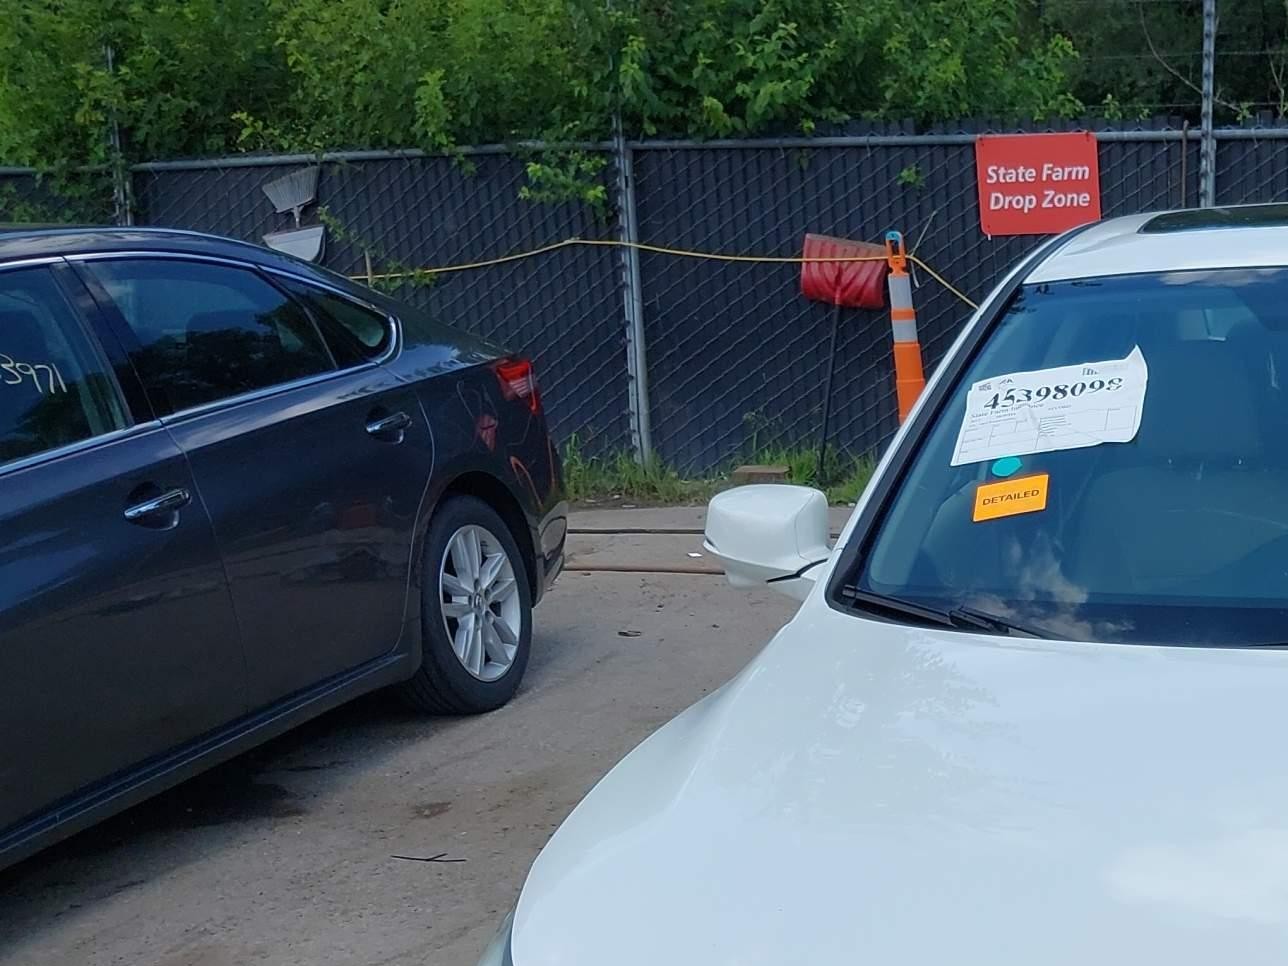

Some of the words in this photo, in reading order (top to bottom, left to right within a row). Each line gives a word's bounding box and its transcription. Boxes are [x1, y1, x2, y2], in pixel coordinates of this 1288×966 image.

[986, 165, 1036, 184] State
[1042, 163, 1090, 182] Farm
[989, 192, 1037, 214] Drop
[1041, 190, 1091, 208] Zone
[982, 489, 1041, 506] DETAILED
